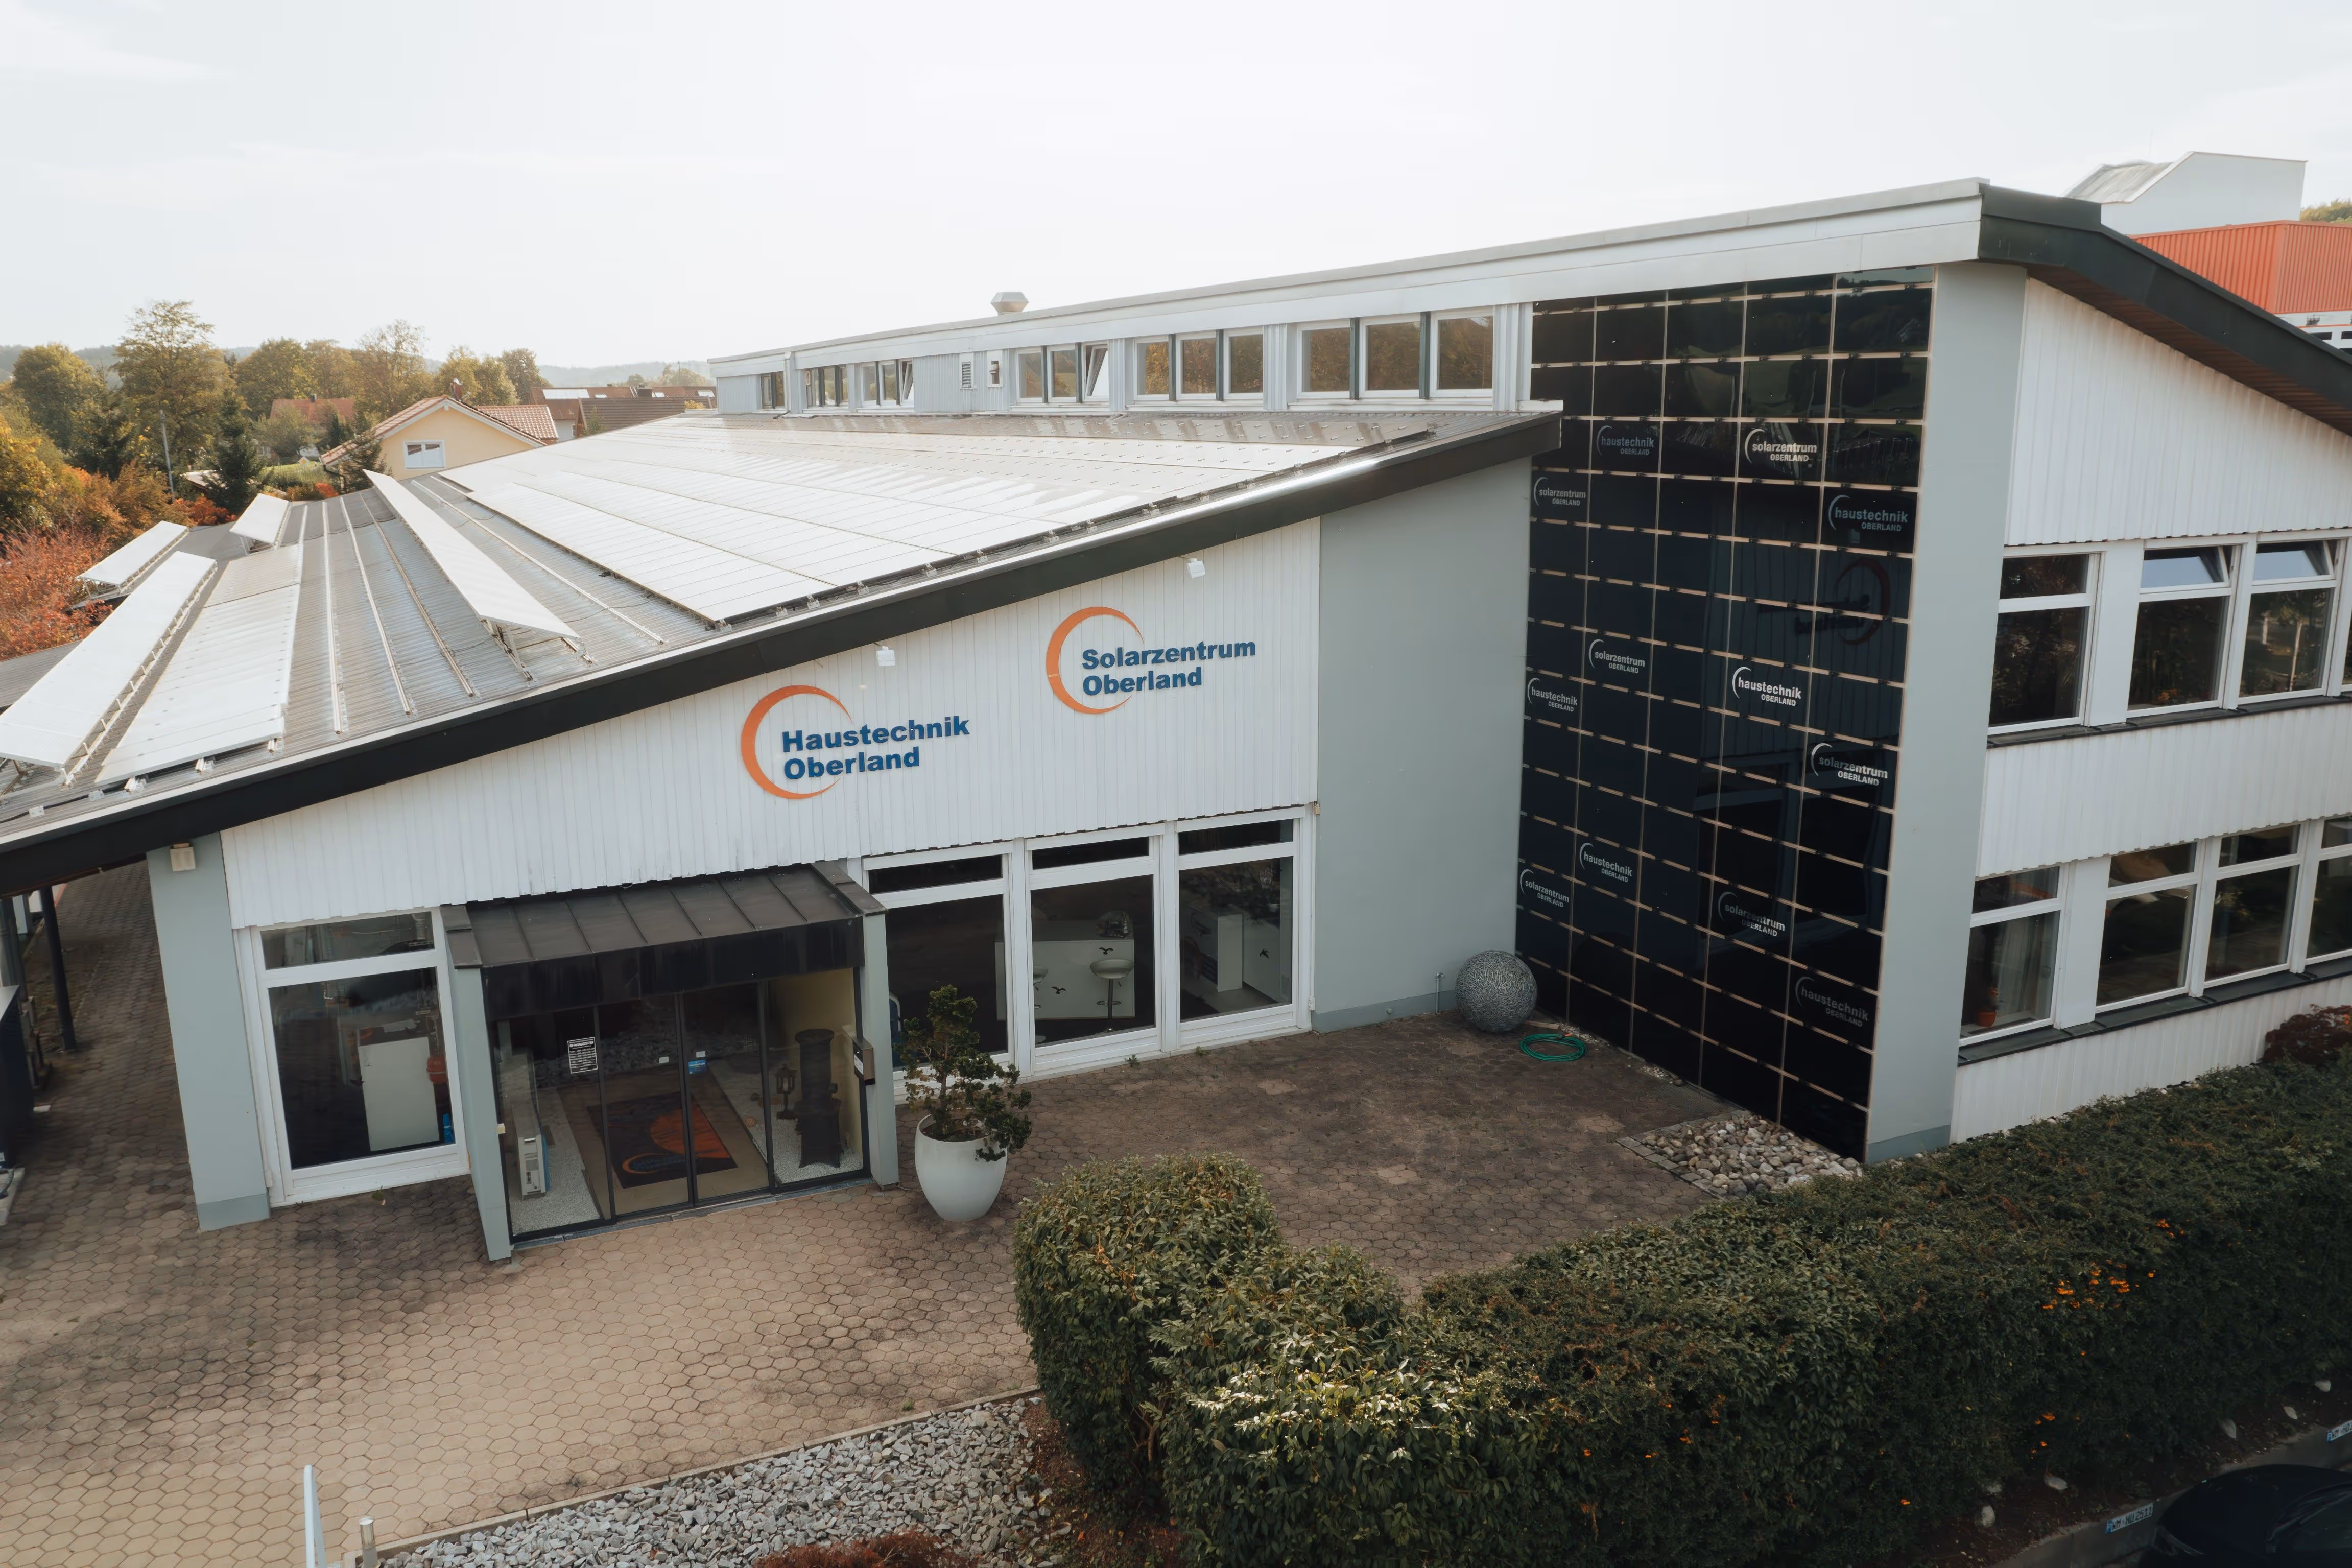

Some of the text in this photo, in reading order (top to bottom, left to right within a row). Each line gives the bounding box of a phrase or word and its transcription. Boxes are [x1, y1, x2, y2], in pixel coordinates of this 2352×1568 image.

[1601, 436, 1654, 449] haustechnik
[1752, 442, 1817, 454] solarzentrum
[1770, 453, 1809, 462] OBERLAND
[1539, 487, 1586, 500] solarzentrum
[1552, 498, 1581, 506] OBERLAND
[1835, 507, 1908, 523] haustechnik
[1861, 521, 1902, 532] OBERLAND
[1081, 638, 1256, 670] Solarzentrum
[1595, 651, 1645, 667] solarzentrum
[1608, 662, 1639, 674] OBERLAND
[1082, 667, 1203, 697] Oberland
[1738, 676, 1802, 700] haustechnik
[1531, 685, 1578, 706] haustechnik
[1761, 693, 1796, 707] OBERLAND
[1548, 700, 1574, 712] OBERLAND
[781, 716, 970, 753] Haustechnik
[783, 747, 920, 780] Oberland
[1818, 755, 1888, 779] solarzentrum
[1837, 770, 1880, 786] OBERLAND
[1583, 851, 1632, 877] haustechnik
[1601, 867, 1629, 883] OBERLAND
[1525, 880, 1569, 903] solarzentrum
[1536, 892, 1564, 908] OBERLAND
[1724, 901, 1786, 932] solarzentrum
[1801, 986, 1869, 1021] haustechnik
